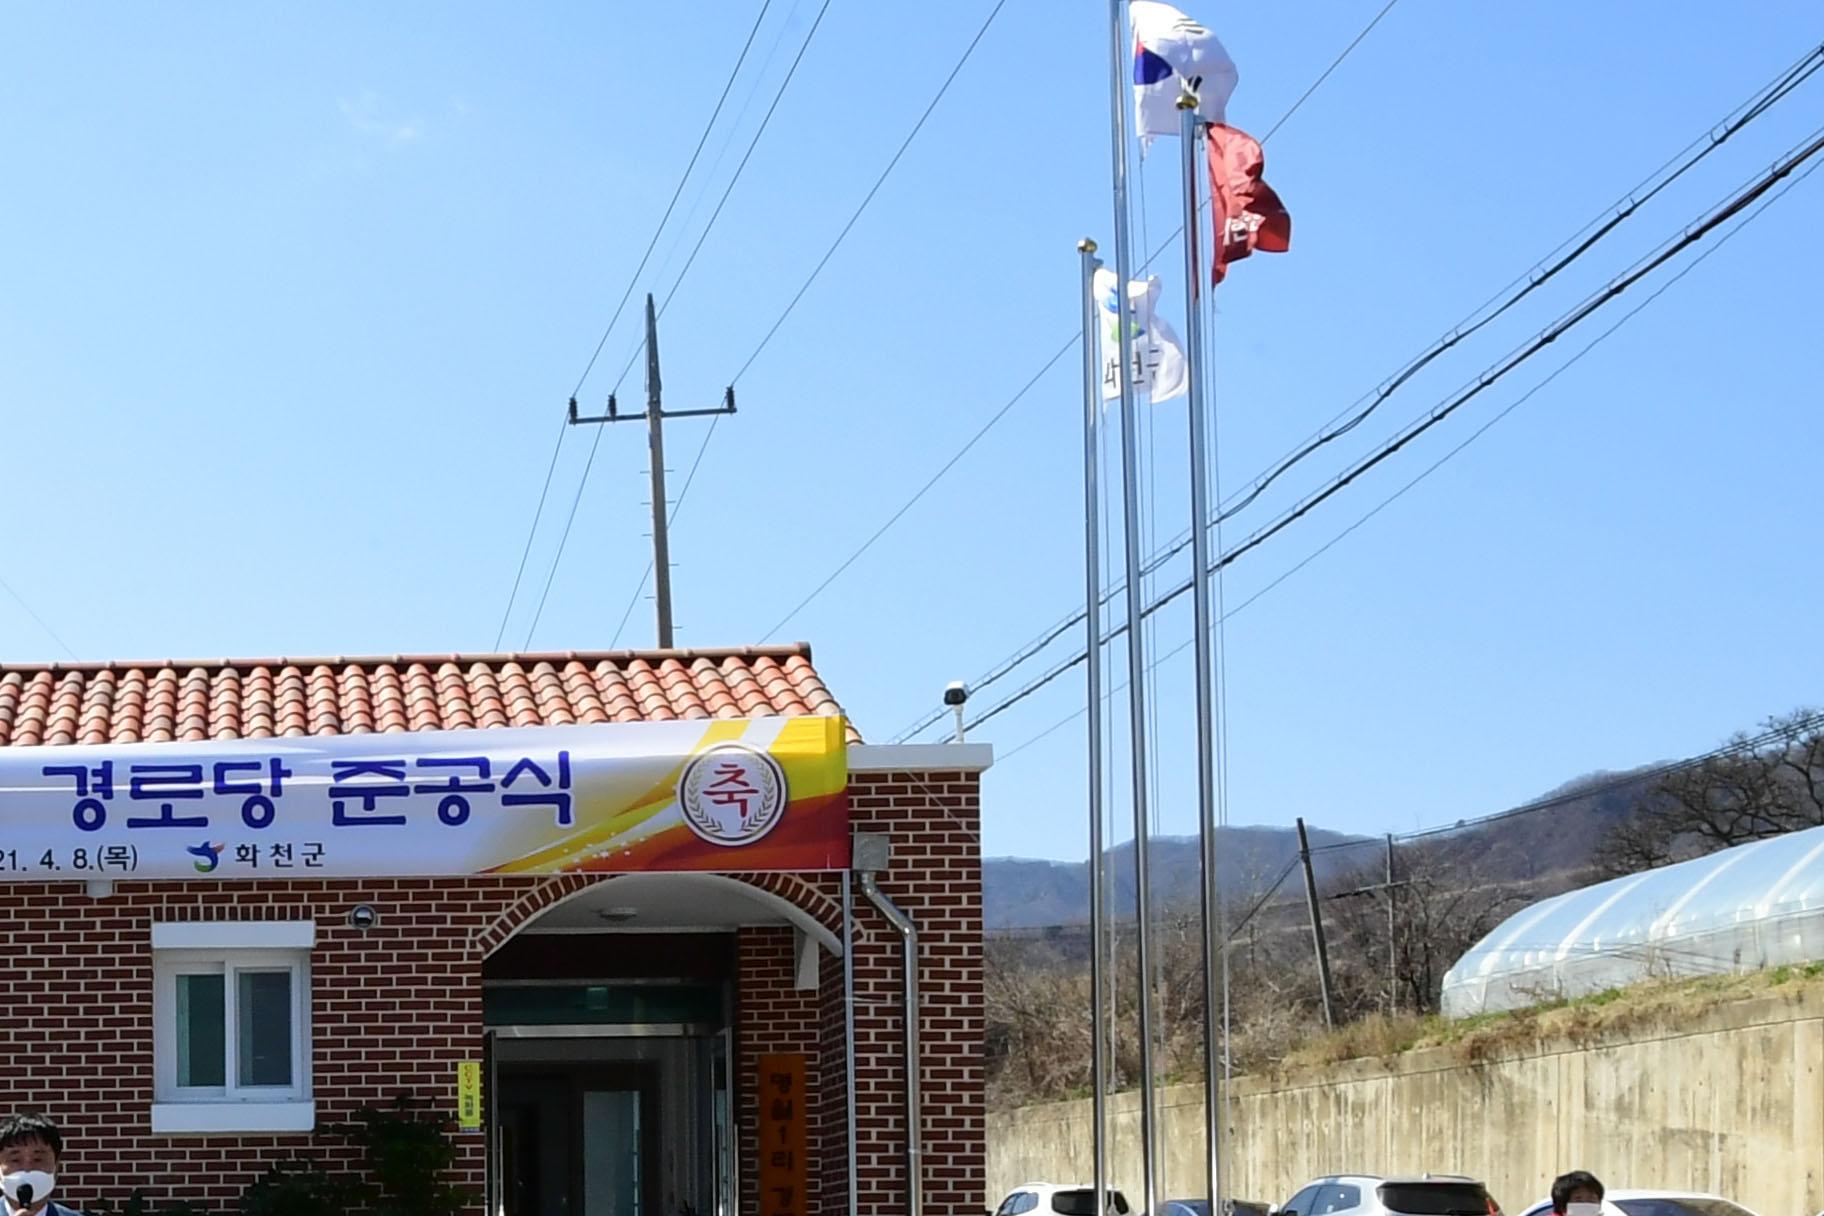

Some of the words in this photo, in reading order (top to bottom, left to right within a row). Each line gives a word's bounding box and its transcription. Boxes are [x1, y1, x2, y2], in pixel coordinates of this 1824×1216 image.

[41, 756, 294, 832] 경로당
[326, 750, 573, 828] 준공식
[702, 760, 760, 818] 축
[39, 848, 62, 872] 4.
[236, 841, 326, 870] 화천군
